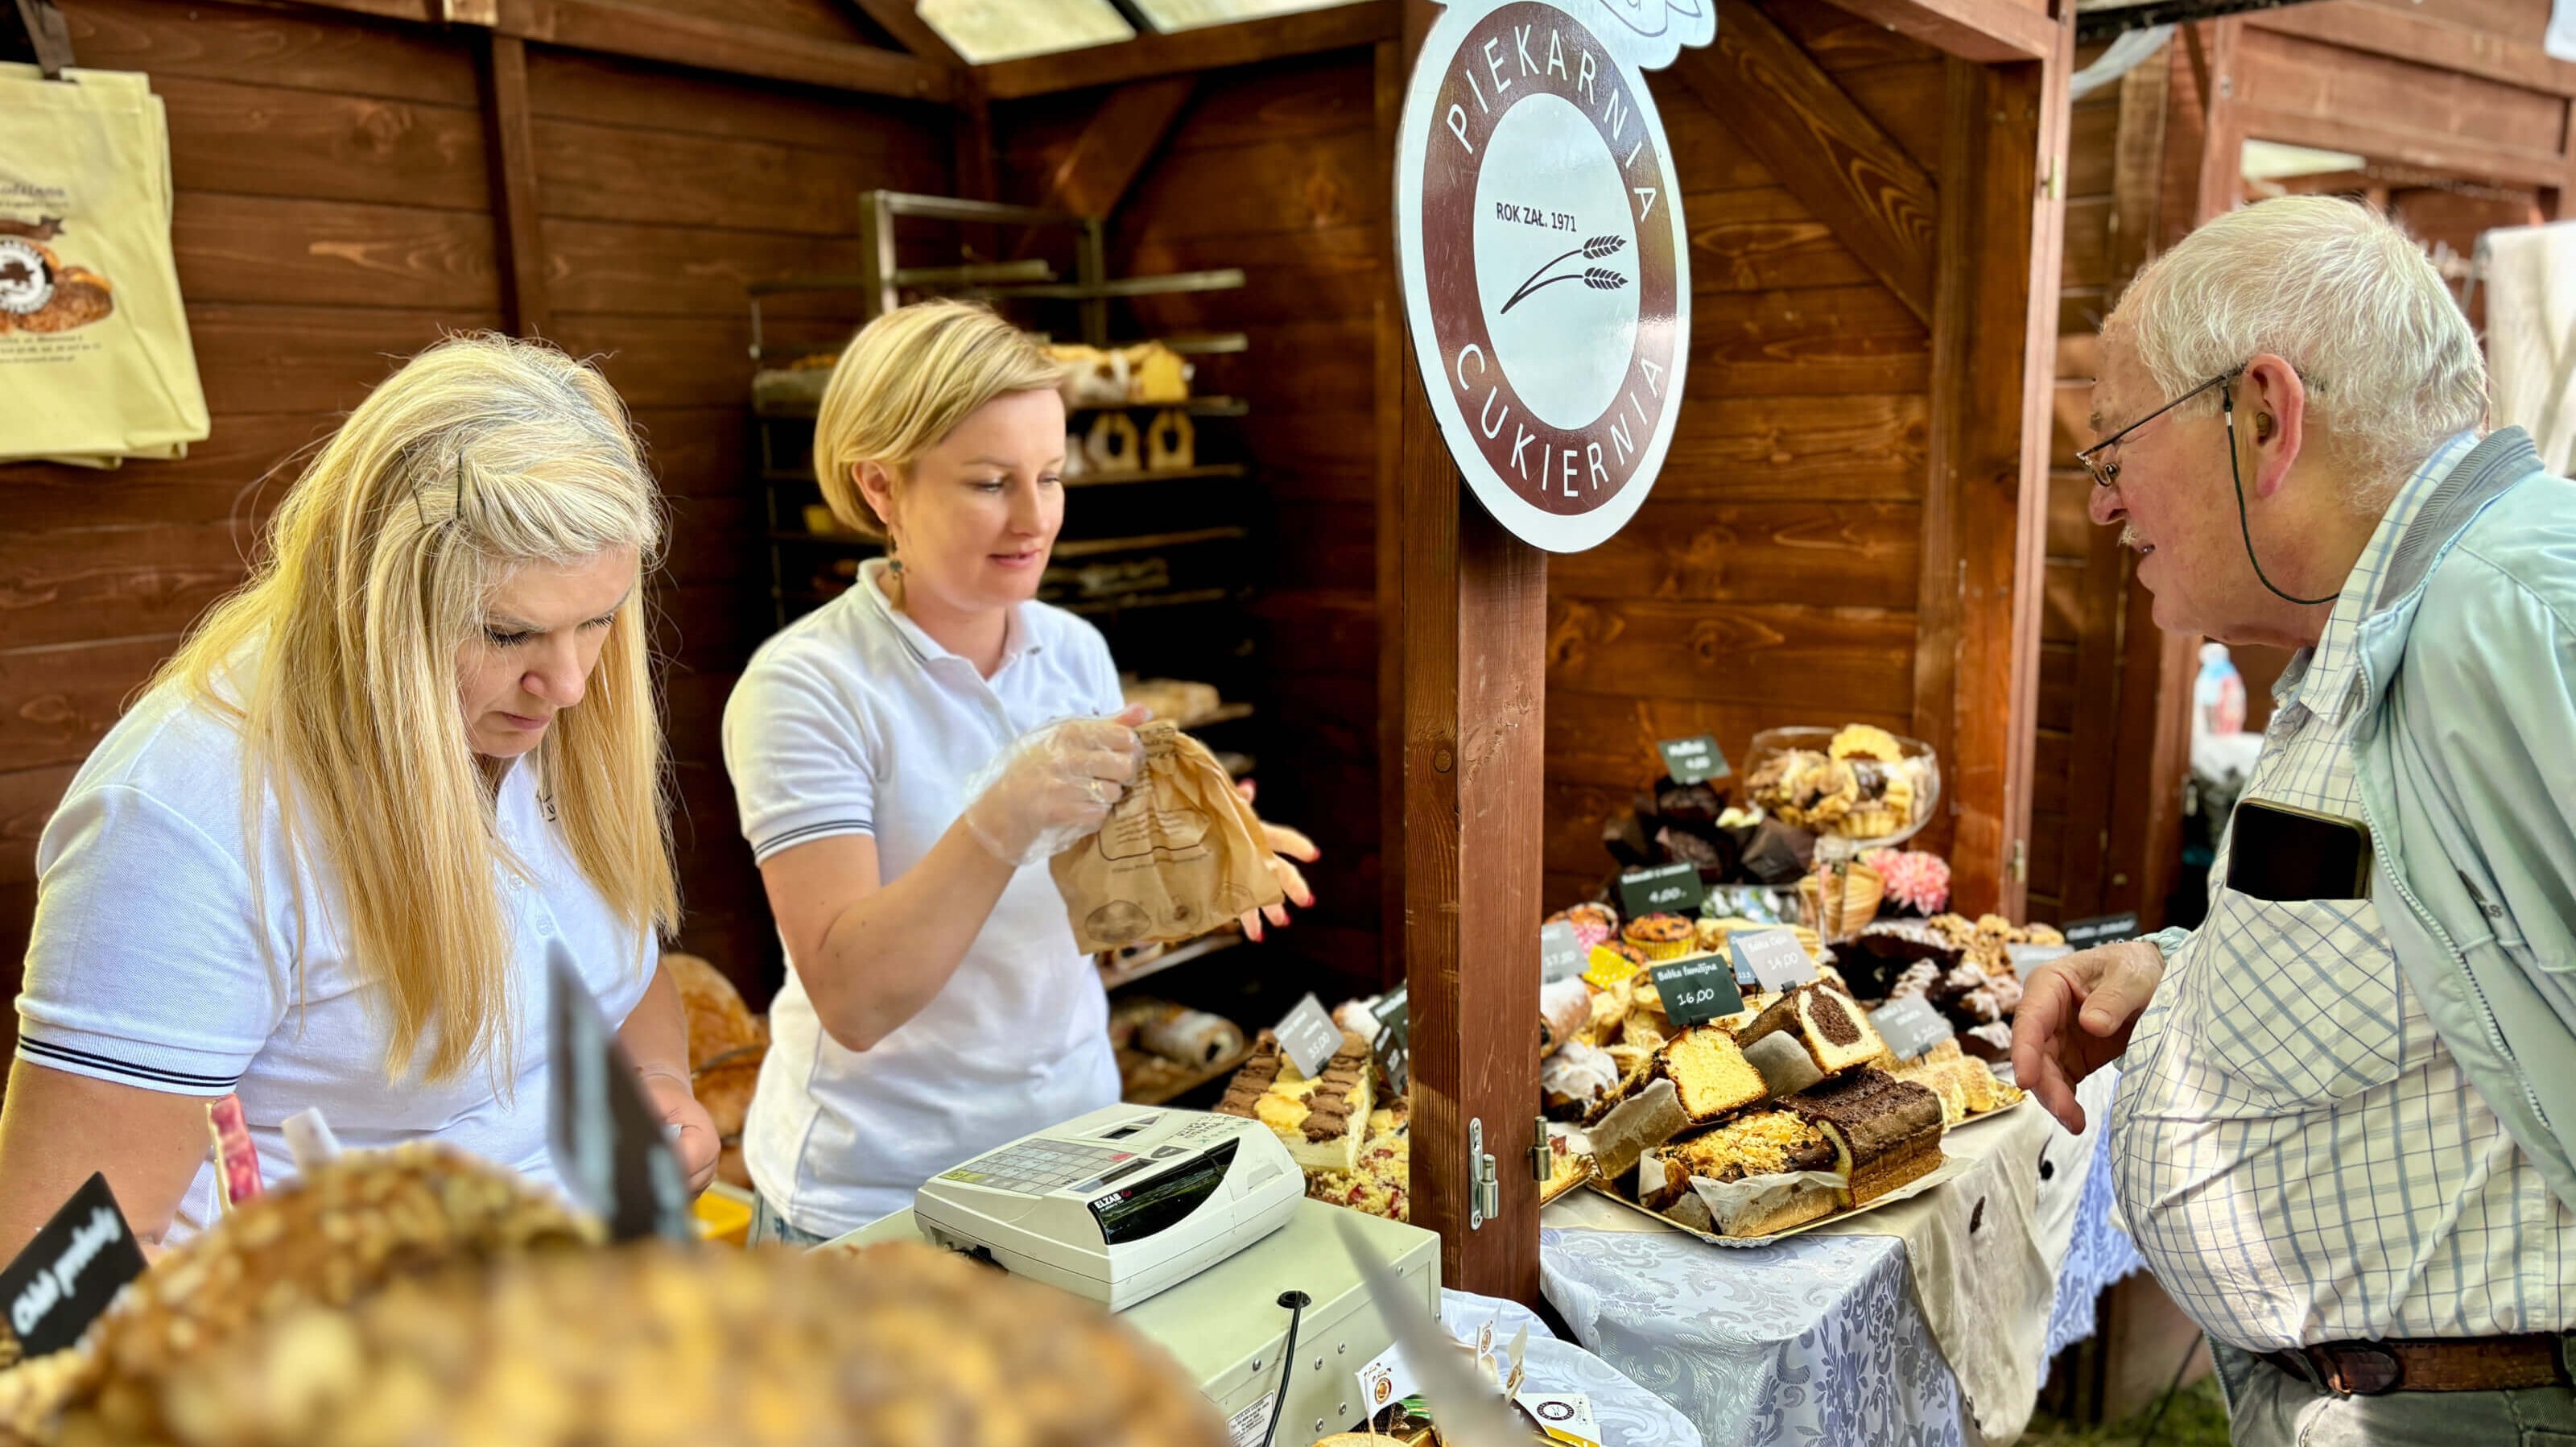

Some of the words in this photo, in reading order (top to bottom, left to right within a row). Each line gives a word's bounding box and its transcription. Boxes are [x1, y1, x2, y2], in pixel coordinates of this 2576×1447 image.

[1447, 24, 1656, 222] PIEKARNIA
[1496, 202, 1521, 223] ROK
[1523, 207, 1547, 228] ZAŁ.
[1551, 212, 1577, 232] 1971
[1457, 344, 1662, 497] CUKIERNIA
[1657, 969, 1682, 982] Babka
[1677, 988, 1715, 1007] 16,00
[1095, 1193, 1121, 1210] ELZAB
